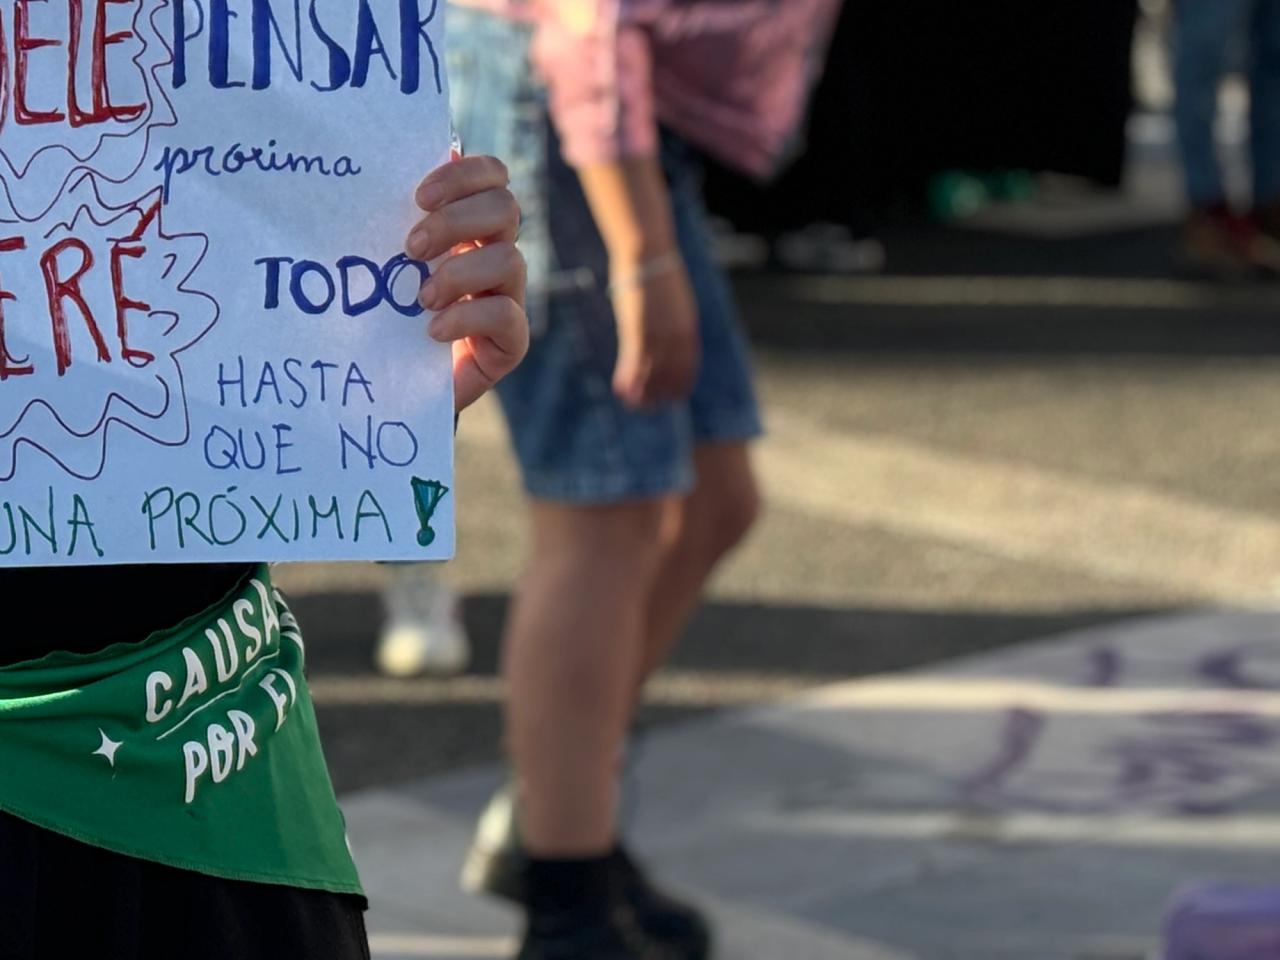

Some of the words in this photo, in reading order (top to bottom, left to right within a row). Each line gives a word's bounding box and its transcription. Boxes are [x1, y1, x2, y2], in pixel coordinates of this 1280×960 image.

[254, 253, 430, 317] TODO
[217, 356, 374, 408] HASTA
[204, 423, 302, 474] QUE
[339, 415, 418, 470] NO
[183, 710, 258, 804] POR
